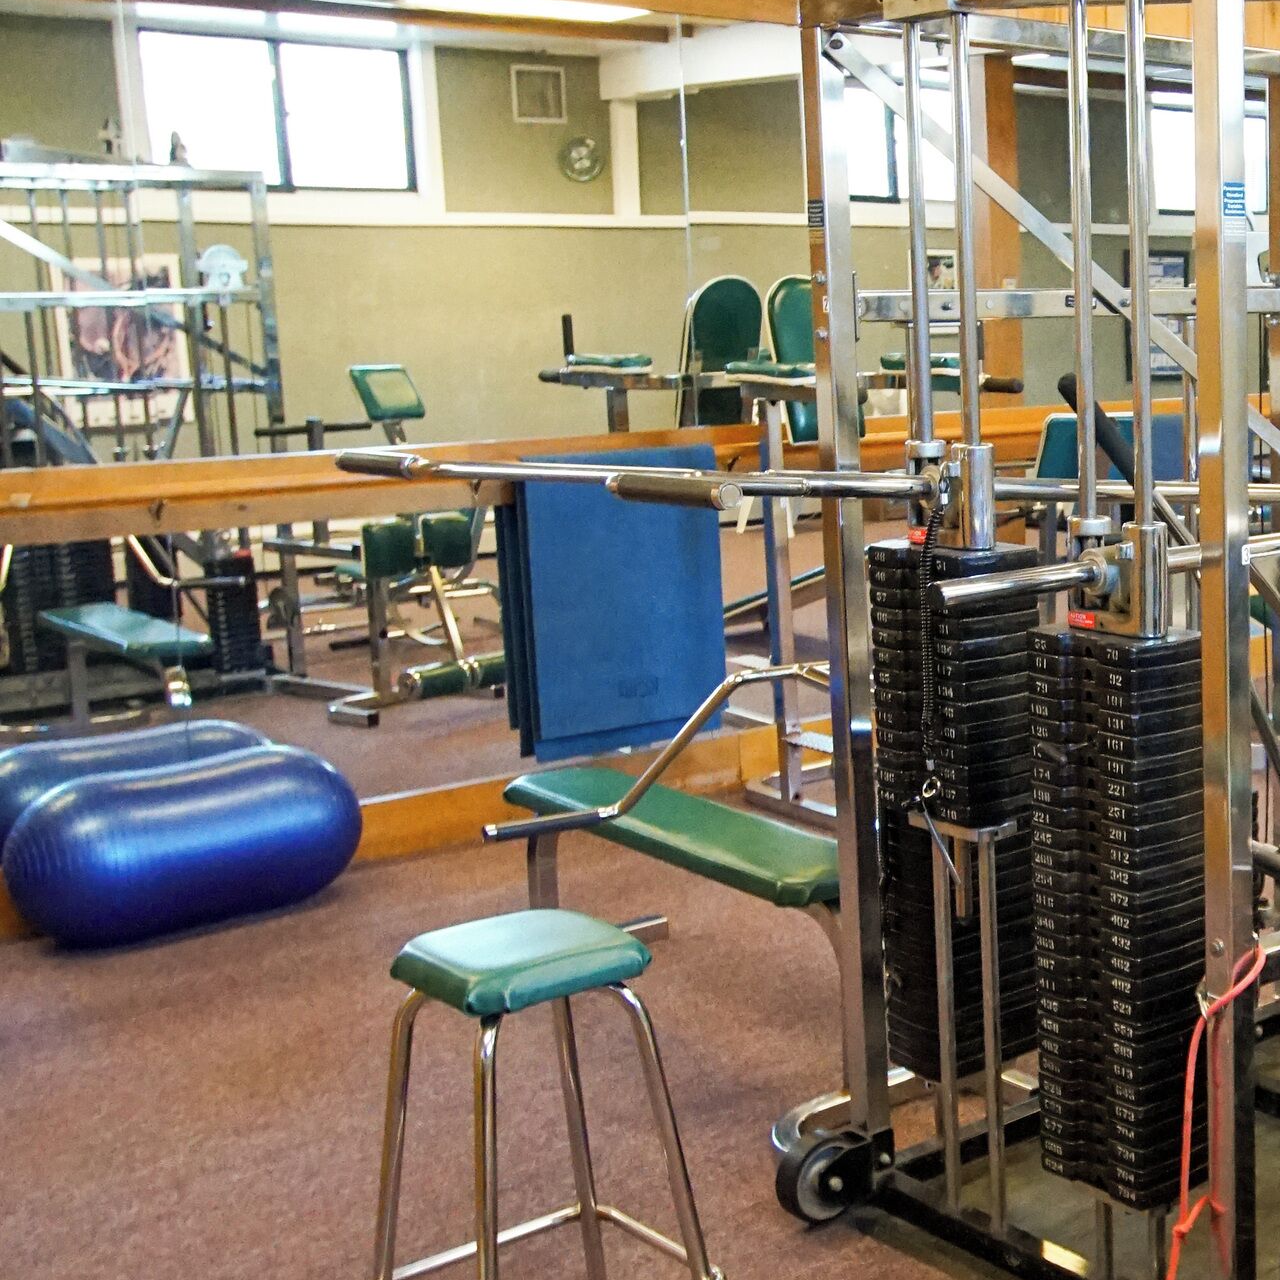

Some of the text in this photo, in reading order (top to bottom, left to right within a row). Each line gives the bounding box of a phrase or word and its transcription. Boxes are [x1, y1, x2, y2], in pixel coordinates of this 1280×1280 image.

[1034, 639, 1047, 651] 55
[1106, 649, 1118, 661] 70
[1036, 657, 1047, 669] 61
[1109, 674, 1122, 686] 92
[1035, 682, 1048, 694] 79
[1031, 703, 1048, 716] 103
[1107, 717, 1124, 730] 131
[1107, 738, 1124, 751] 161
[1107, 761, 1124, 775] 191
[1108, 783, 1125, 797] 221
[1033, 810, 1050, 824] 221
[1108, 806, 1126, 820] 251
[1110, 850, 1130, 864] 312
[1110, 870, 1129, 885] 342
[1110, 892, 1129, 907] 372
[1111, 914, 1130, 929] 402
[1111, 935, 1130, 950] 432
[1039, 978, 1056, 991] 411
[1112, 999, 1132, 1015] 523
[1114, 1064, 1134, 1080] 613
